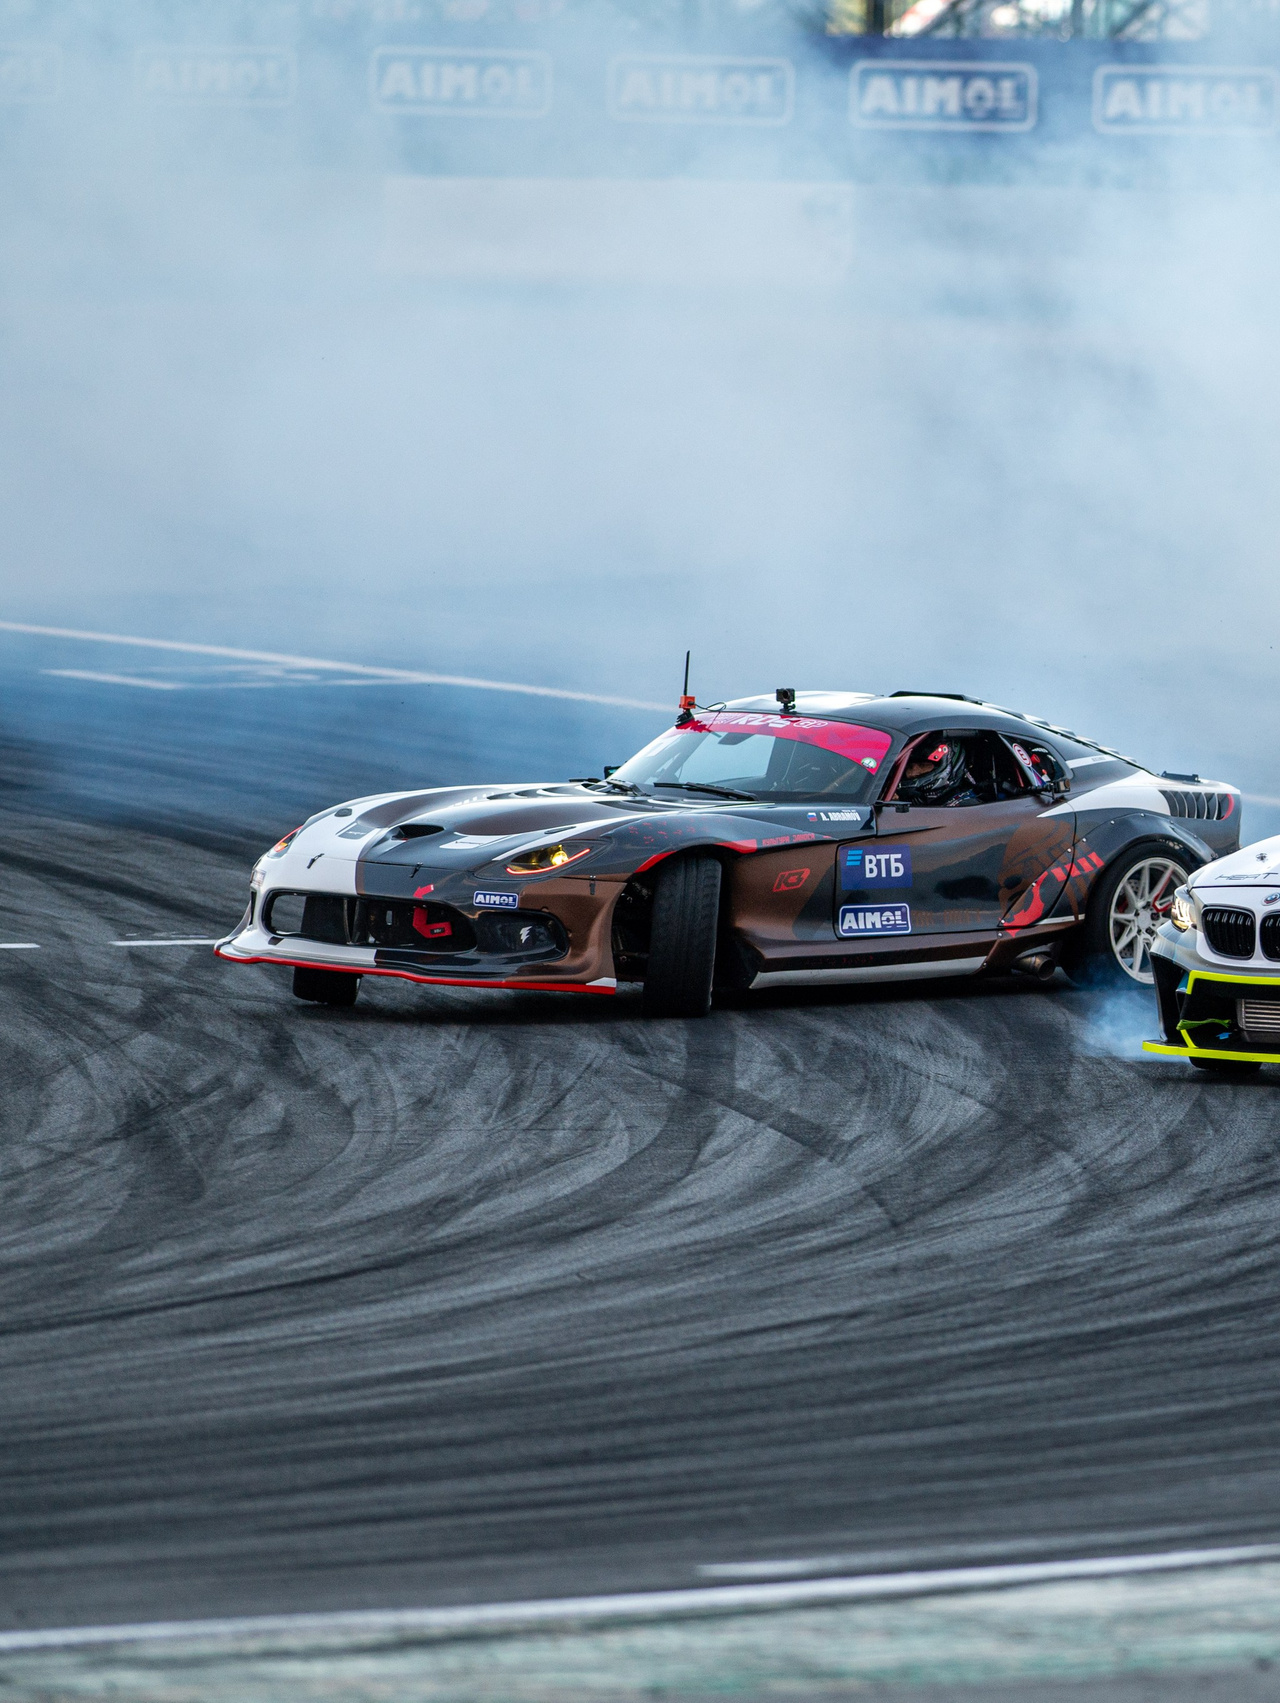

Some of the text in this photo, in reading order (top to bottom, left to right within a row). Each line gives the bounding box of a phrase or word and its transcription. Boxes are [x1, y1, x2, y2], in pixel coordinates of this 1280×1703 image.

[380, 61, 535, 100] AIMOL
[618, 70, 780, 108] AIMOL
[860, 74, 1025, 118] AIMOL
[1104, 79, 1266, 120] AIMOL
[865, 853, 904, 879] ВТБ
[1215, 872, 1278, 881] HEAT
[475, 894, 516, 905] AIMOL
[842, 910, 907, 930] AIMOL
